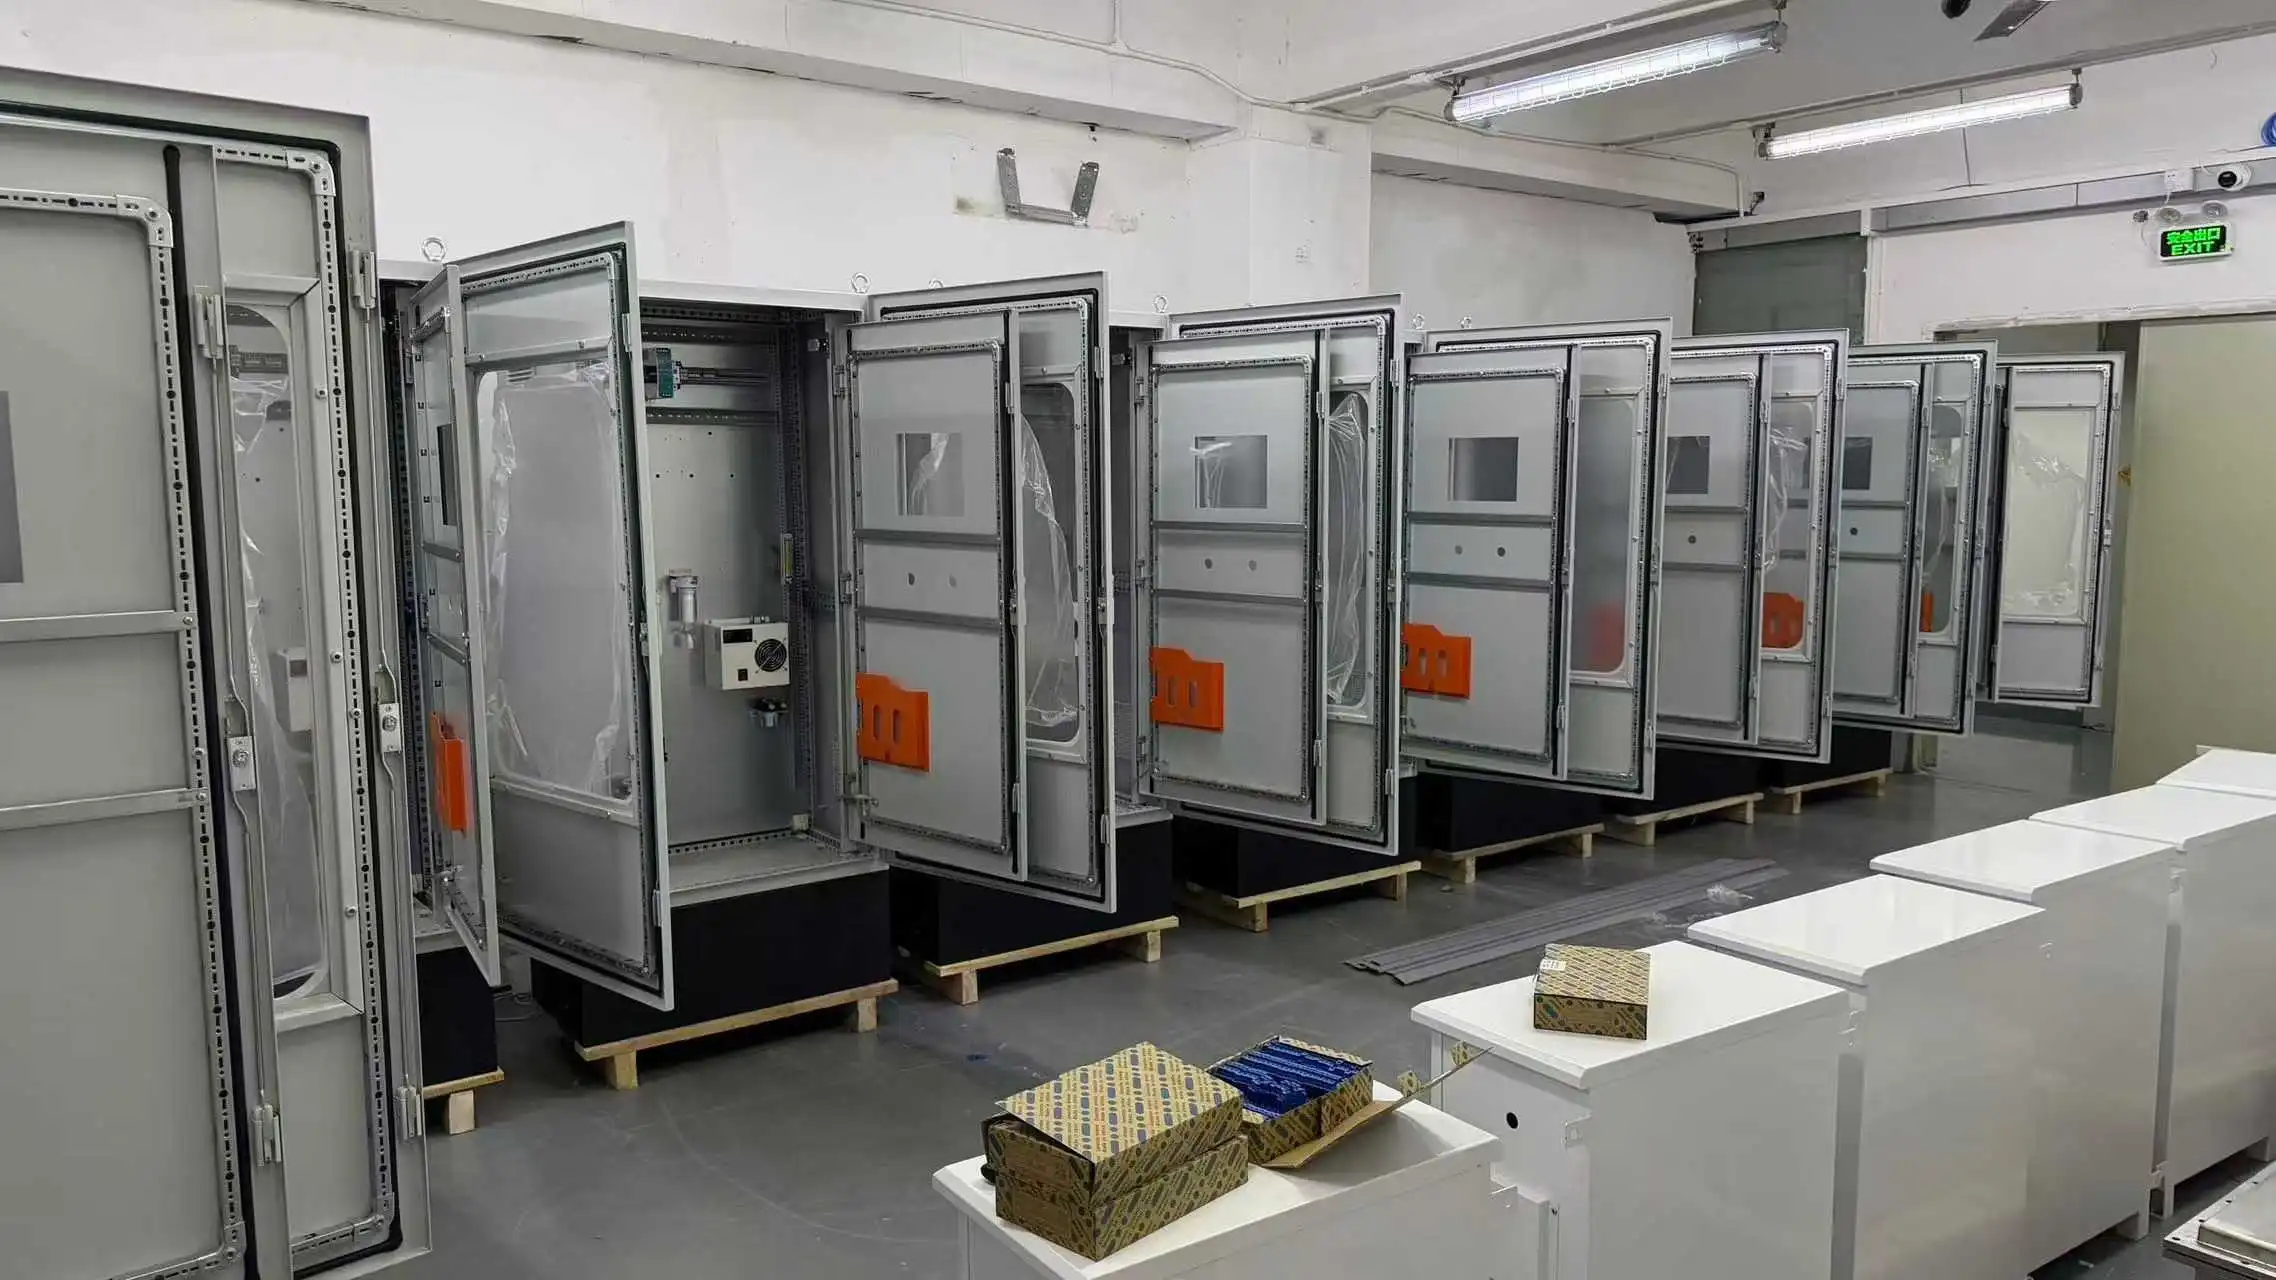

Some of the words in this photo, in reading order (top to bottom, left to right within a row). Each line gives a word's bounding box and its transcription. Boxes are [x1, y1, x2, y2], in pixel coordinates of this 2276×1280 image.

[2167, 227, 2221, 244] 安全出口
[2171, 241, 2215, 255] EXIT
